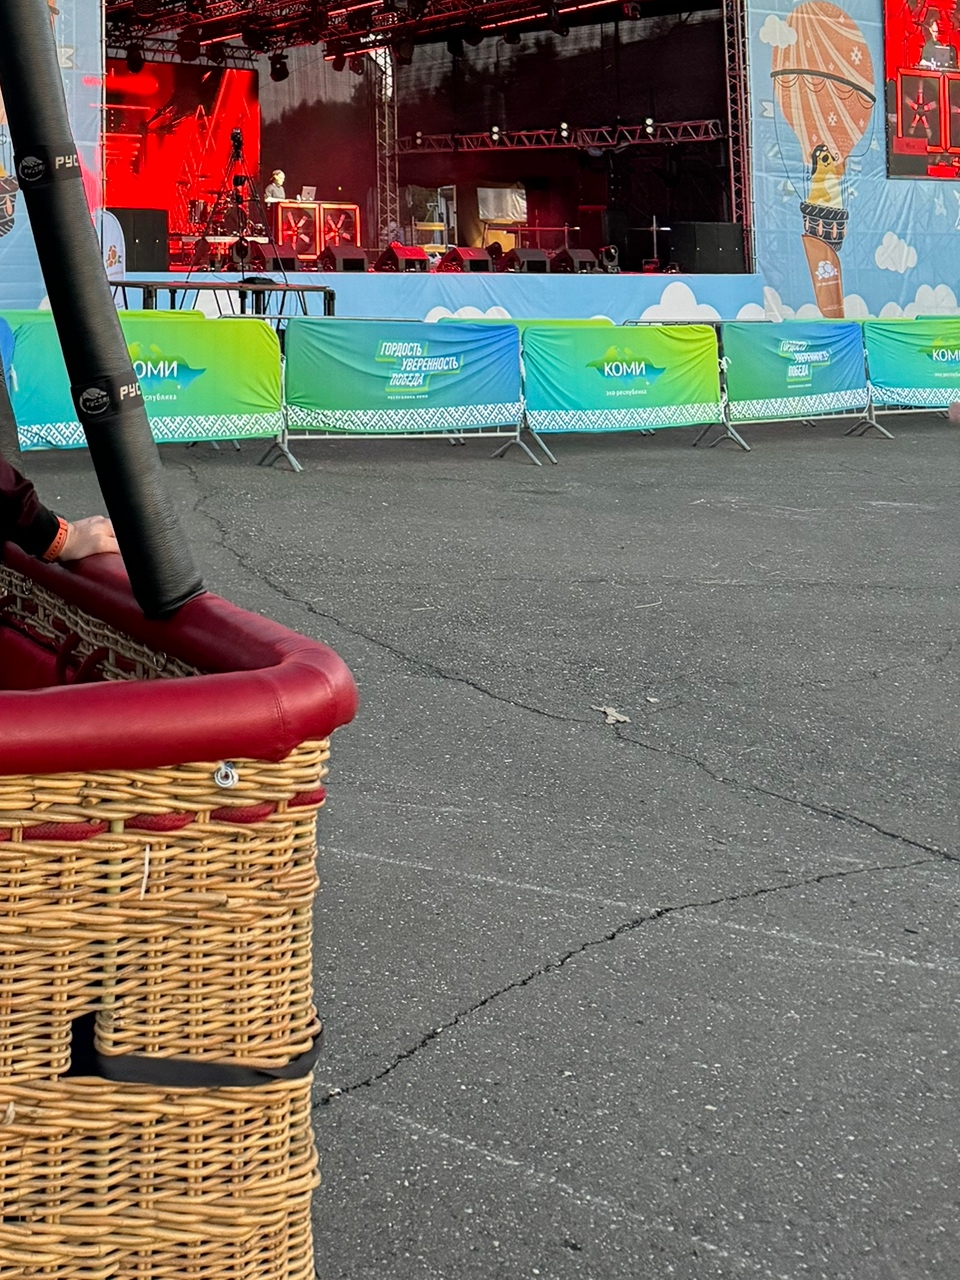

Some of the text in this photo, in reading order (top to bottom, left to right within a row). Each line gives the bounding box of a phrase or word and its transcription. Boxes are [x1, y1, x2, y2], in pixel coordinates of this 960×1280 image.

[380, 342, 423, 358] ГОРДОСТЬ
[133, 360, 178, 379] ОМИ
[401, 356, 460, 371] УВЕРЕННОСТЬ
[604, 360, 646, 377] КОМИ
[389, 372, 425, 387] ПОБЕДА
